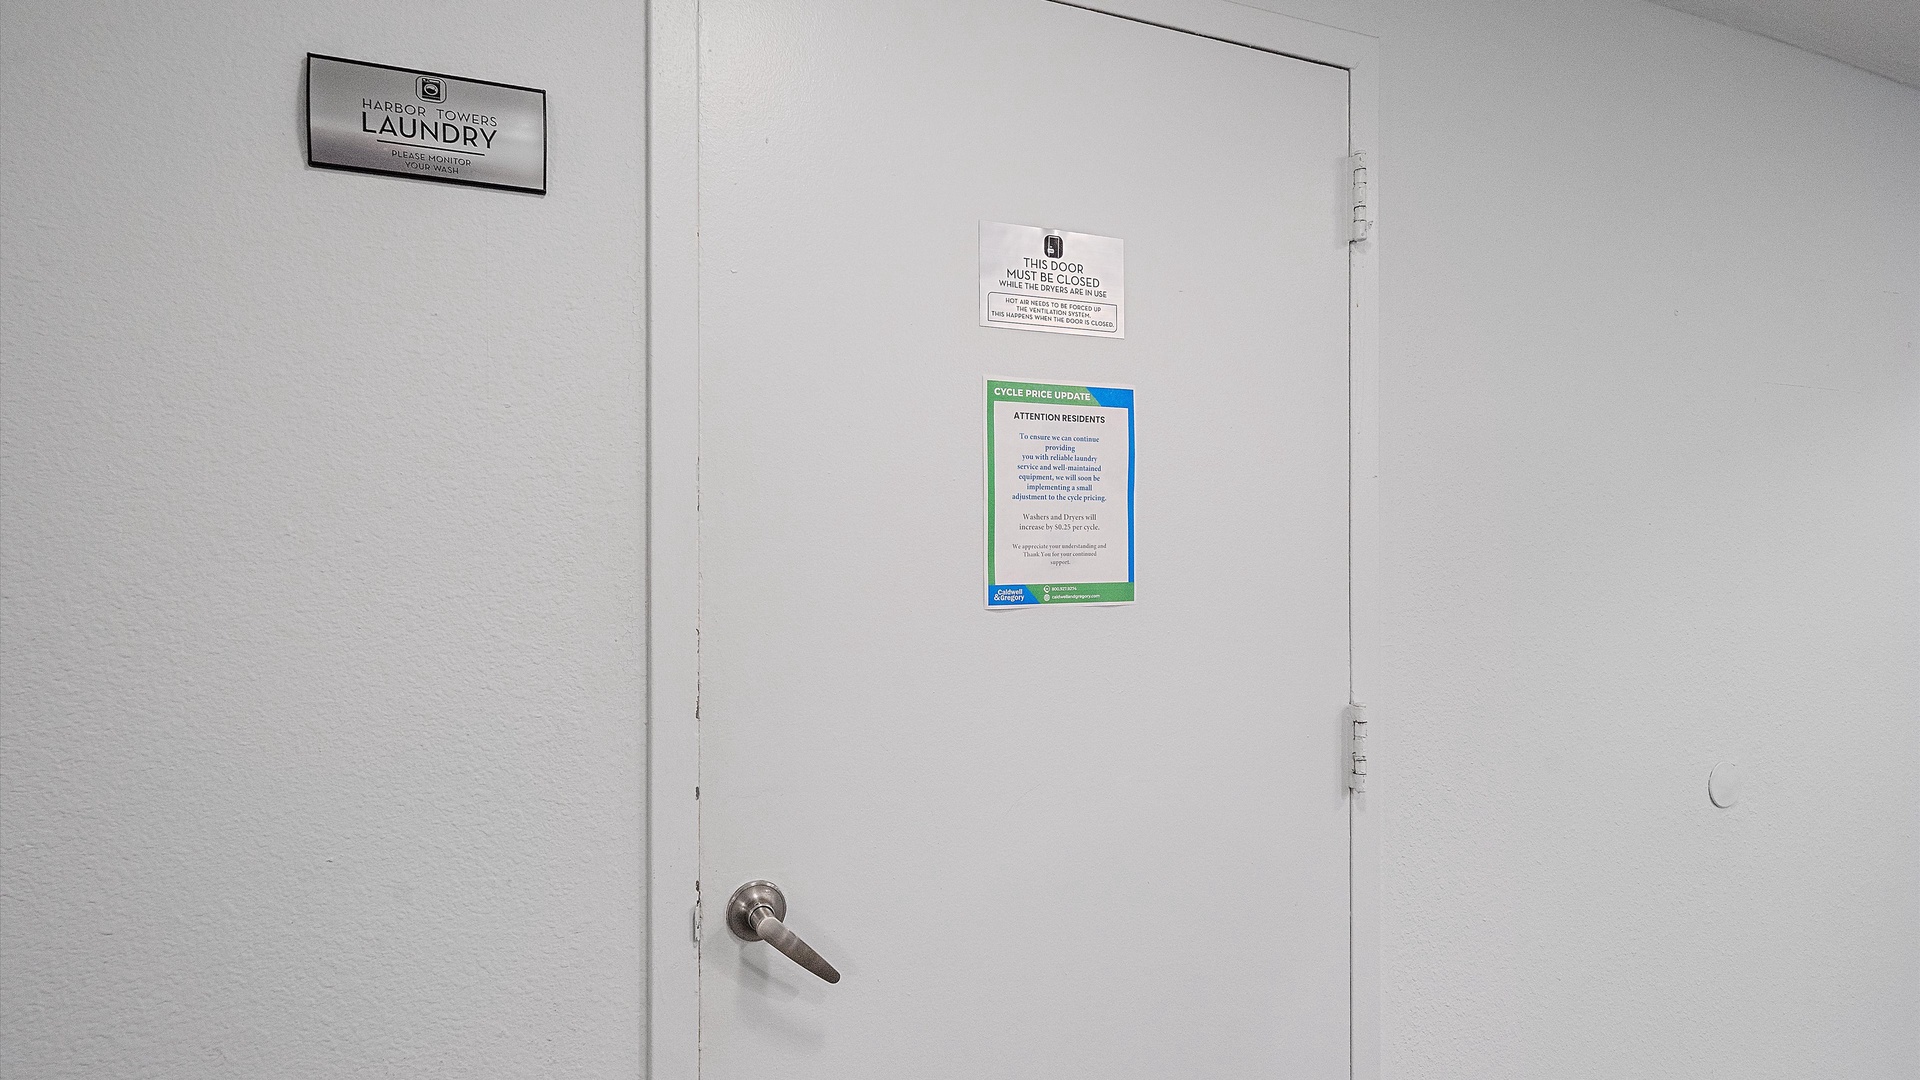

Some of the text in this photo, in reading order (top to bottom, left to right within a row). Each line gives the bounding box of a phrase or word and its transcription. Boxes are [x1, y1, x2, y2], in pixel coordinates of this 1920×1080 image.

[362, 98, 497, 127] HARBOR TOWERS
[362, 111, 497, 149] LAUNDRY
[392, 150, 471, 166] PLEASE MONITOR
[405, 161, 459, 174] YOUR WASH
[1023, 257, 1084, 274] THIS DOOR
[1007, 269, 1100, 288] MUST BE CLOSED
[999, 280, 1107, 298] WHILE THE DRYERS ARE IN USE
[1029, 307, 1067, 316] VENTILATION
[1069, 304, 1092, 312] FORCED
[1006, 312, 1033, 320] HAPPENS
[994, 388, 1091, 401] CYCLE PRICE UPDATE
[1014, 412, 1105, 424] ATTENTION RESIDENTS
[1045, 444, 1076, 453] providing
[1074, 455, 1097, 463] laundry
[1053, 464, 1102, 472] well-maintained
[1018, 474, 1054, 482] equipment,
[1027, 484, 1070, 492] implementing
[1012, 493, 1047, 501] adjustment
[1068, 494, 1082, 502] cycle
[1083, 494, 1106, 503] pricing.
[1064, 514, 1084, 522] Dryers
[1046, 524, 1053, 532] by
[1083, 524, 1100, 532] cycle.
